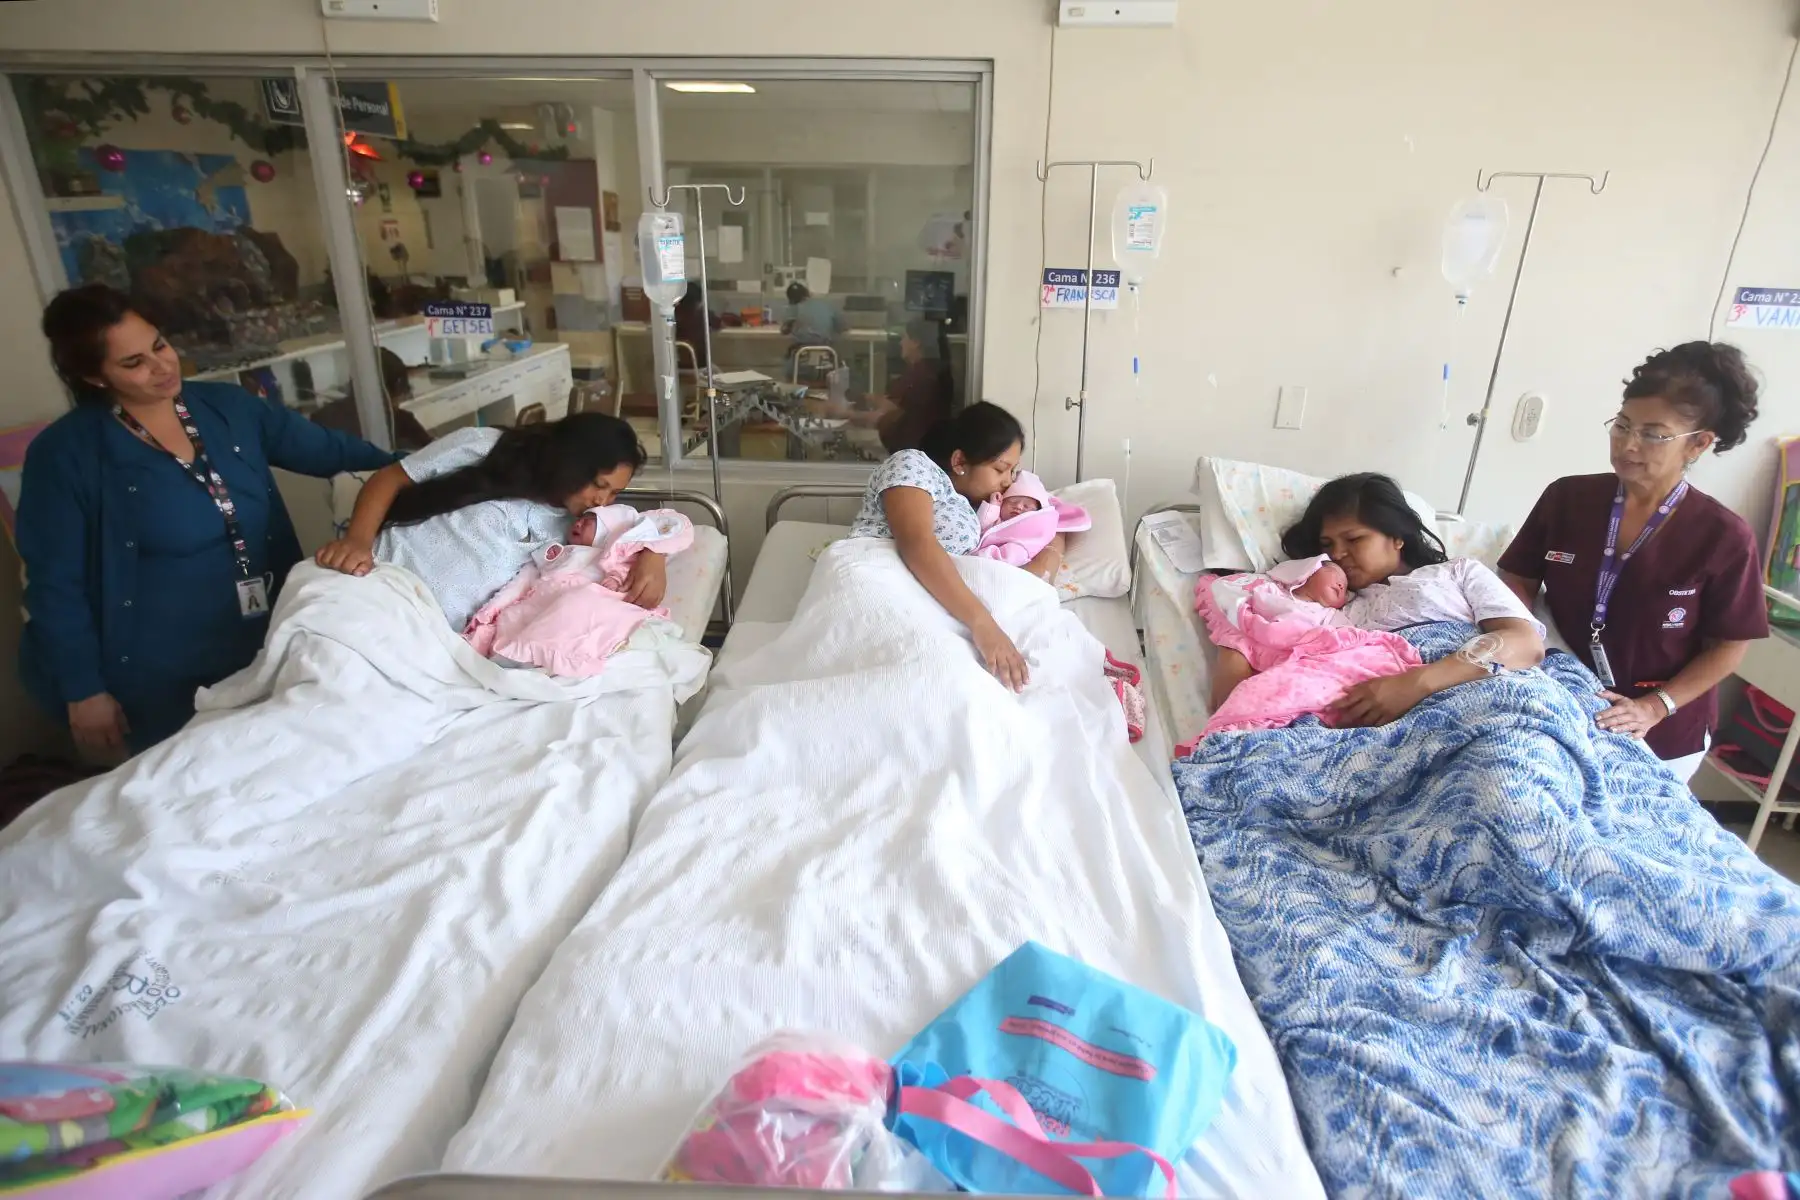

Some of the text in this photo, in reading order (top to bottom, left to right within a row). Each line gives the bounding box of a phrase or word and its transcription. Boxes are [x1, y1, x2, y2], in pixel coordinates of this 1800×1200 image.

[352, 96, 389, 116] Personal
[1047, 271, 1115, 285] Cama N 236
[1056, 286, 1116, 303] FRANSCA
[1740, 290, 1772, 303] Cama
[1790, 293, 1800, 304] 2
[427, 304, 454, 316] Cama
[470, 306, 488, 317] 237
